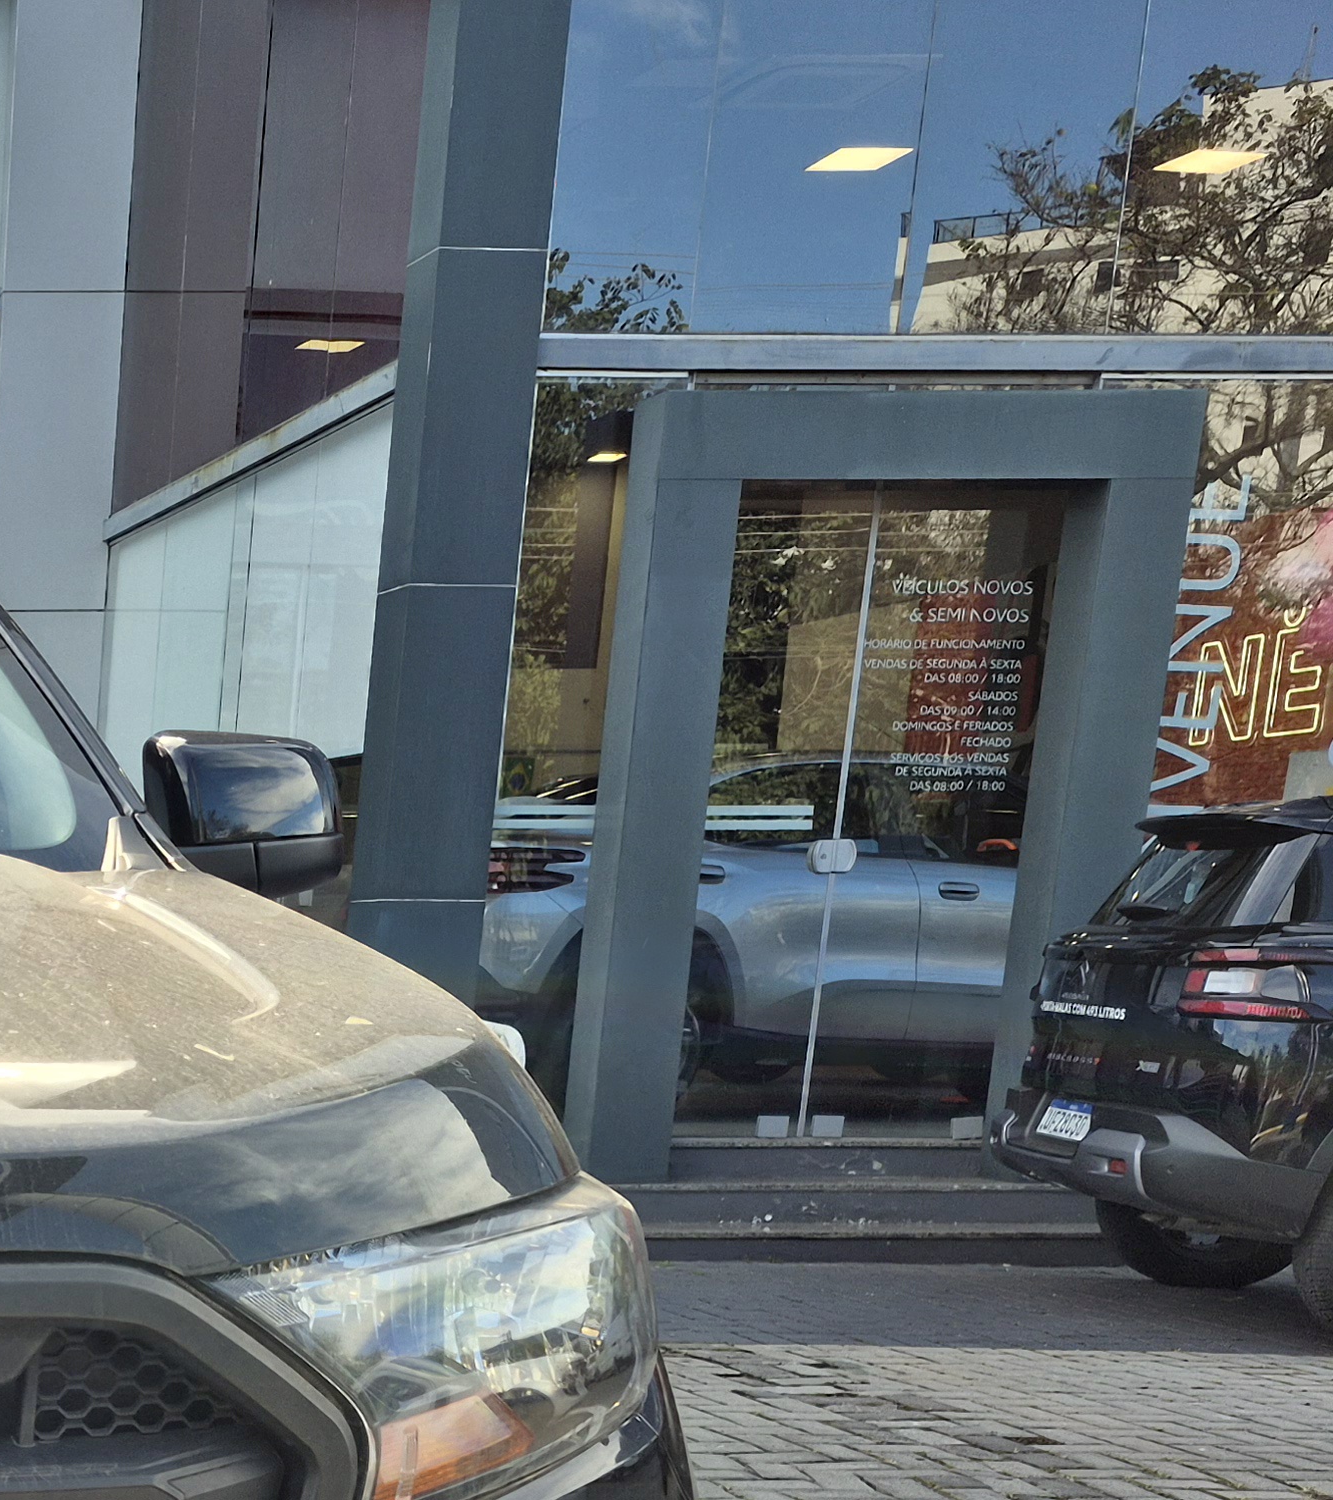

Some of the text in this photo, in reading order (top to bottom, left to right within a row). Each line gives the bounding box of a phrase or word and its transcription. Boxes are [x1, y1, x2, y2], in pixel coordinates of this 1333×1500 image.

[892, 575, 1033, 595] VEÍCULOS NOVOS
[909, 607, 1030, 623] & SEMI NOVOS
[864, 637, 1025, 650] HORÁRIO DE FUNCIONAMENTO
[1146, 474, 1252, 818] VENUE
[864, 659, 907, 669] VENDAS
[909, 659, 924, 669] DE
[926, 659, 977, 670] SEGUNDA
[989, 660, 1022, 670] SEXTA
[924, 673, 946, 684] DAS
[948, 673, 979, 684] 08:00
[991, 674, 1021, 684] 18:00
[968, 689, 1019, 702] SÁBADOS
[920, 705, 942, 716] DAS
[987, 706, 1016, 716] 14:00
[893, 721, 953, 732] DOMINGOS
[963, 721, 1014, 732] FERIADOS
[960, 736, 1012, 748] FECHADO
[966, 752, 1009, 763] VENDAS
[895, 766, 910, 776] DE
[911, 766, 962, 777] SEGUNDA
[974, 766, 1007, 776] SEXTA
[909, 780, 931, 792] DAS
[933, 780, 964, 792] 08:00
[976, 781, 1006, 791] 18:00
[1099, 1006, 1127, 1020] LITROS
